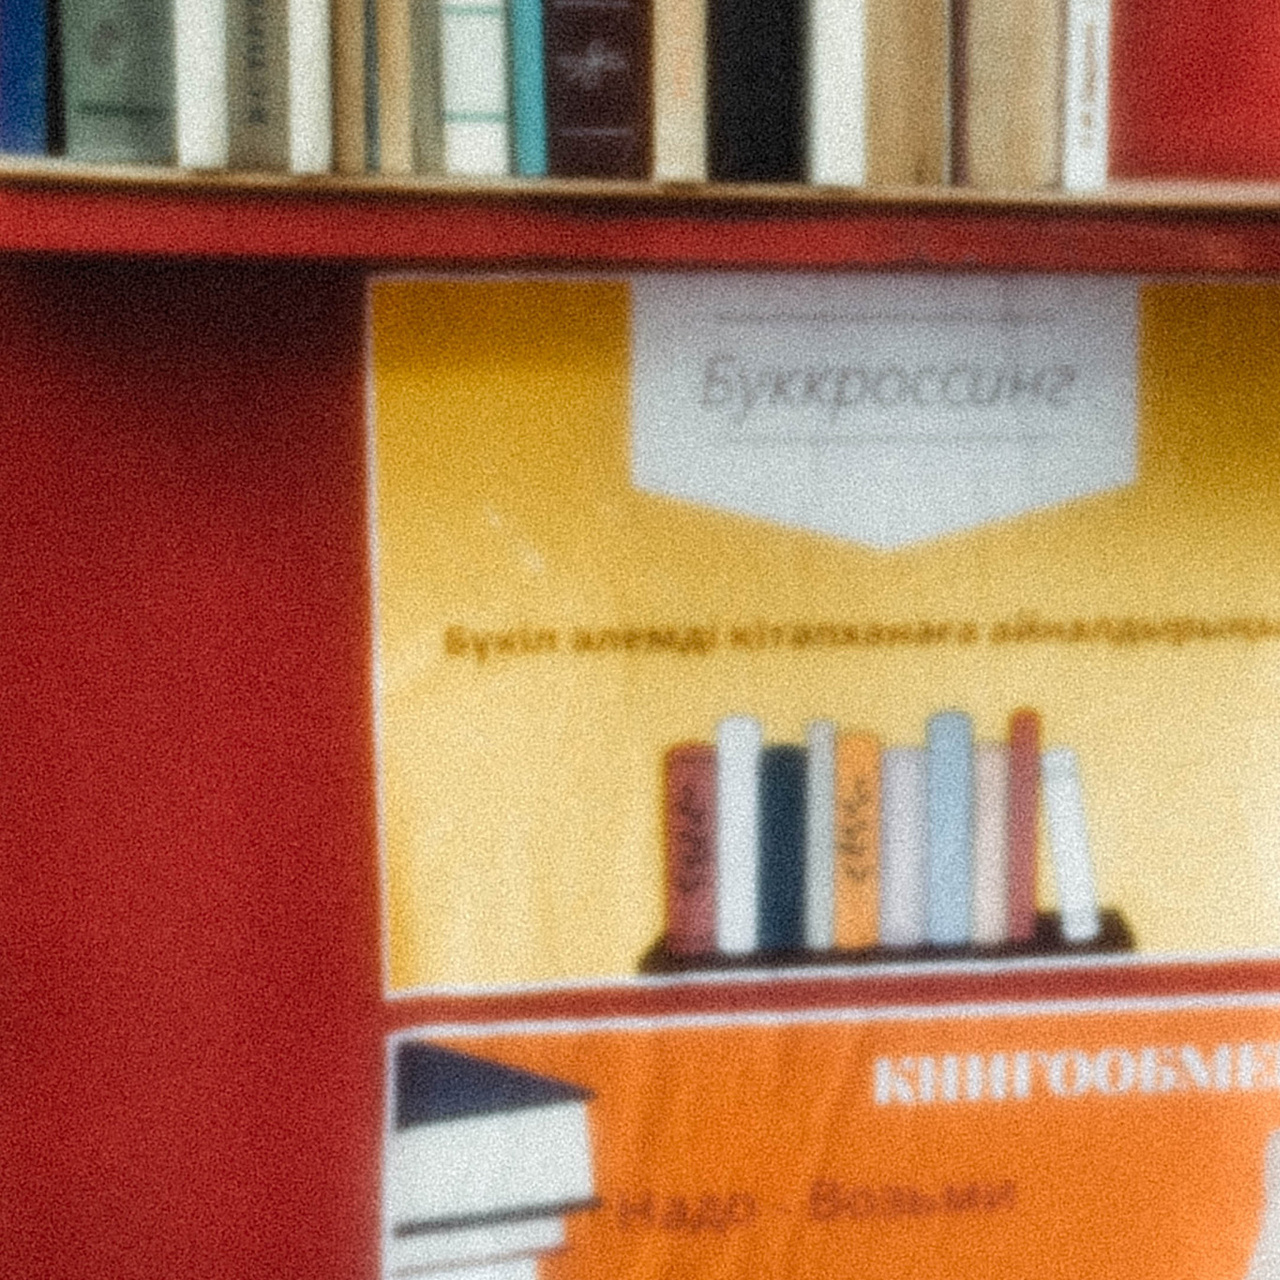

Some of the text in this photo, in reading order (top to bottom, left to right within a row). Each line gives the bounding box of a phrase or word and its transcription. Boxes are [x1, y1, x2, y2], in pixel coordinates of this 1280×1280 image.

[701, 352, 1077, 426] Буккроссинг
[616, 1187, 757, 1236] Надо
[808, 1176, 1017, 1223] Возьми
